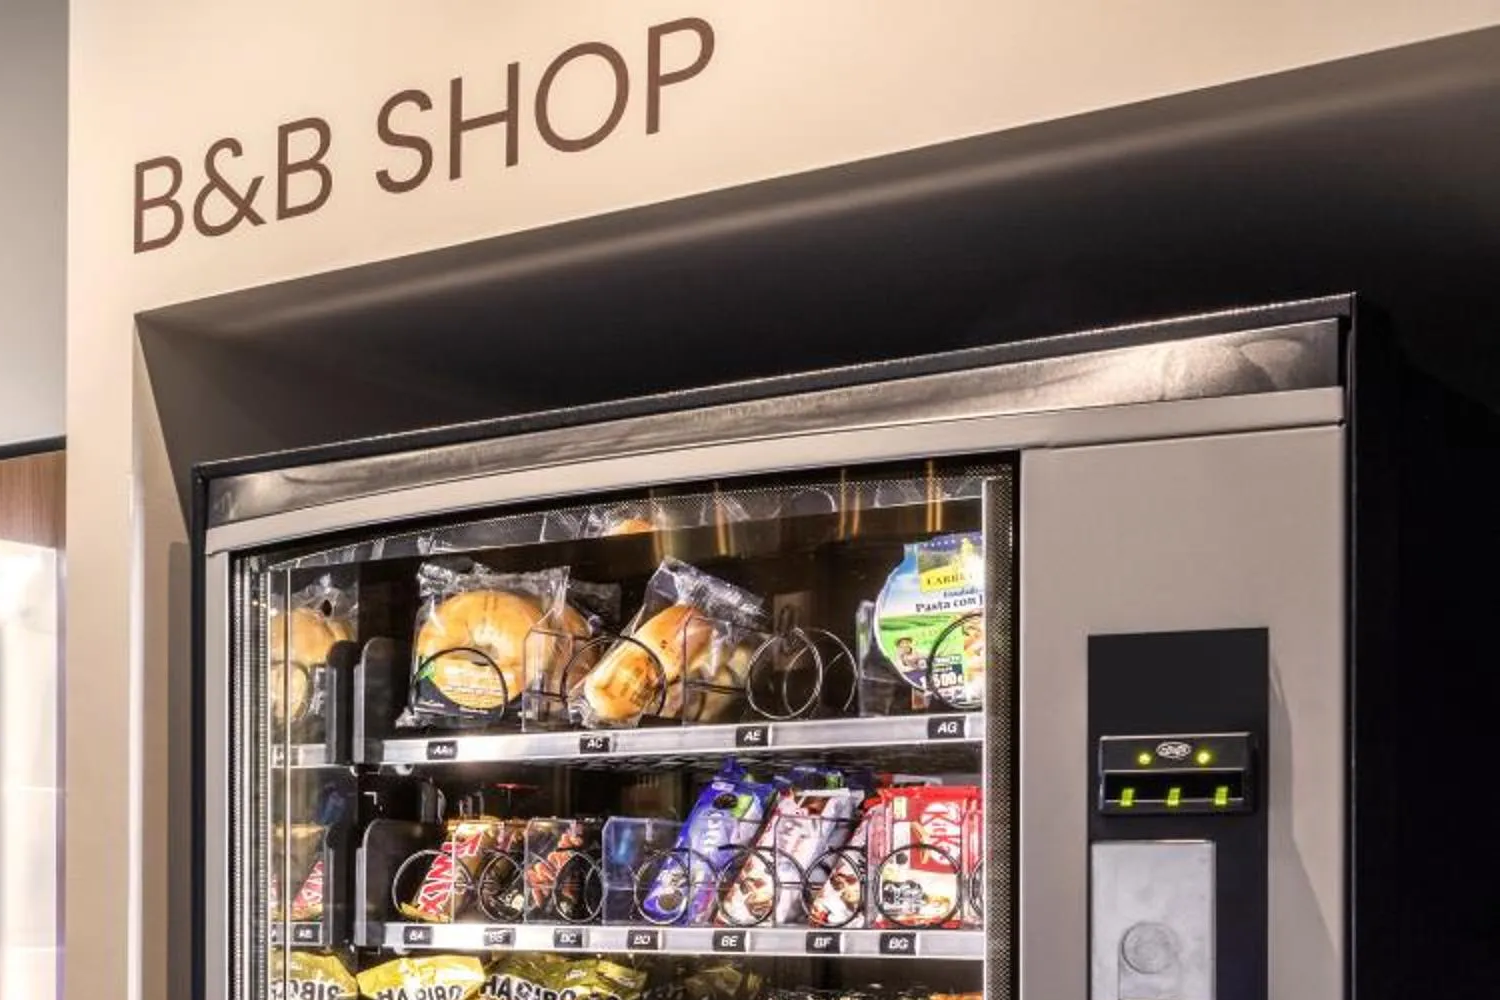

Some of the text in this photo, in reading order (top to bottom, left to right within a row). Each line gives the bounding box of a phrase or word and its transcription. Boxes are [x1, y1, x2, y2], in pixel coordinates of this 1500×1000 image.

[133, 16, 716, 254] B&B SHOP
[937, 721, 958, 734] AG
[743, 729, 762, 742] AE
[587, 738, 603, 749] AC
